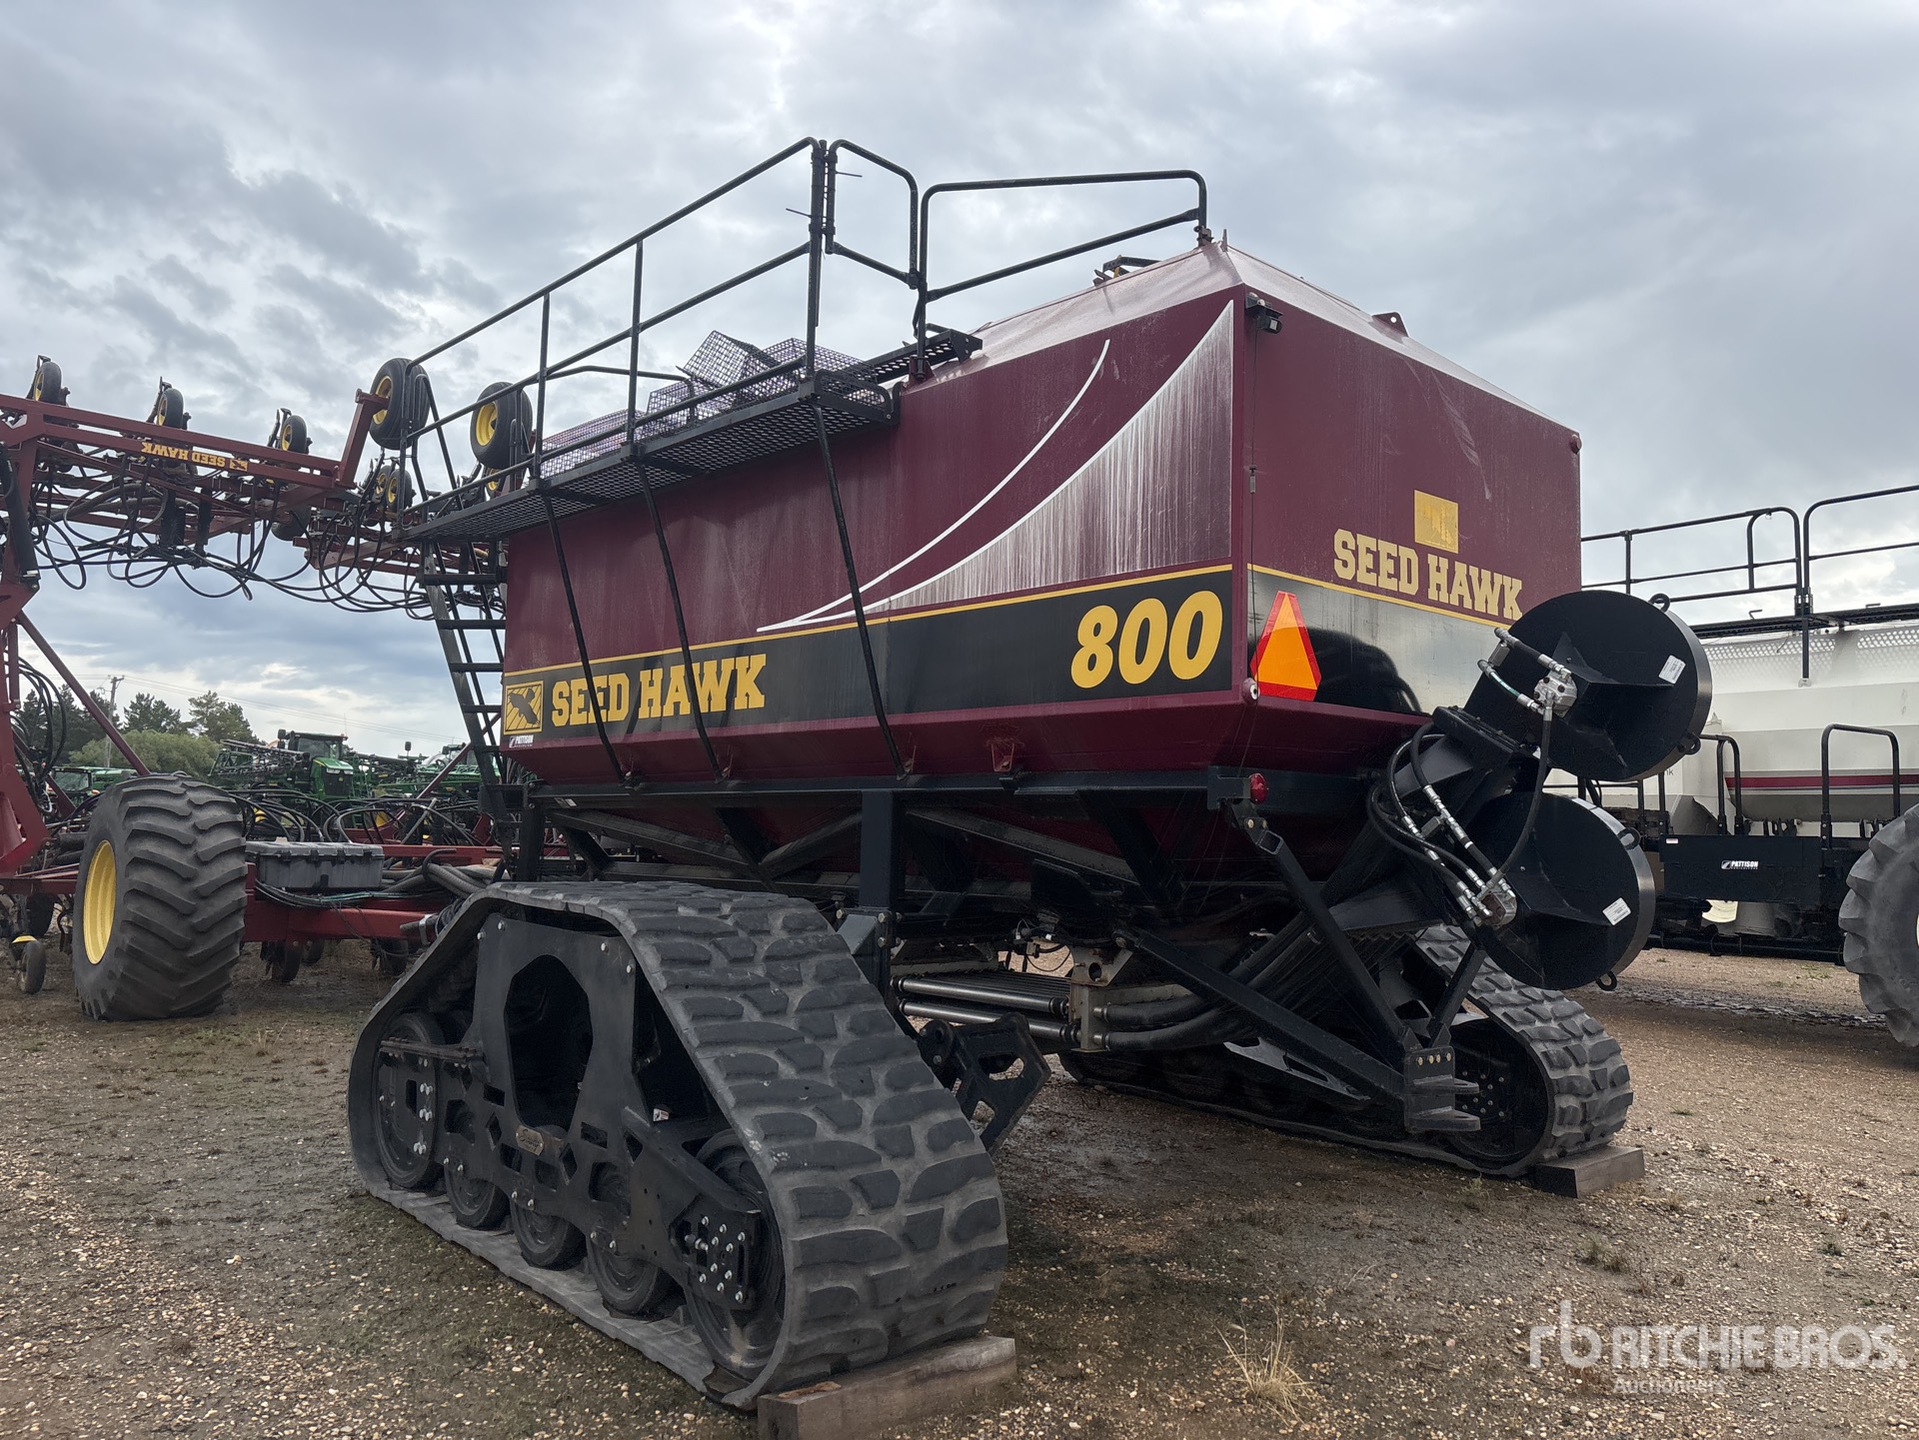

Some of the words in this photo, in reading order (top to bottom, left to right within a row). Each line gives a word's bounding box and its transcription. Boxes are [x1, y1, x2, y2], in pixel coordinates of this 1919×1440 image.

[141, 441, 189, 461] HAWK
[191, 450, 226, 468] SEED
[1333, 527, 1419, 596] SEED
[1427, 552, 1523, 621] HAWK
[1070, 589, 1224, 690] 800
[551, 672, 630, 728] SEED
[637, 653, 768, 720] HAWK
[1731, 860, 1759, 868] PATTISON
